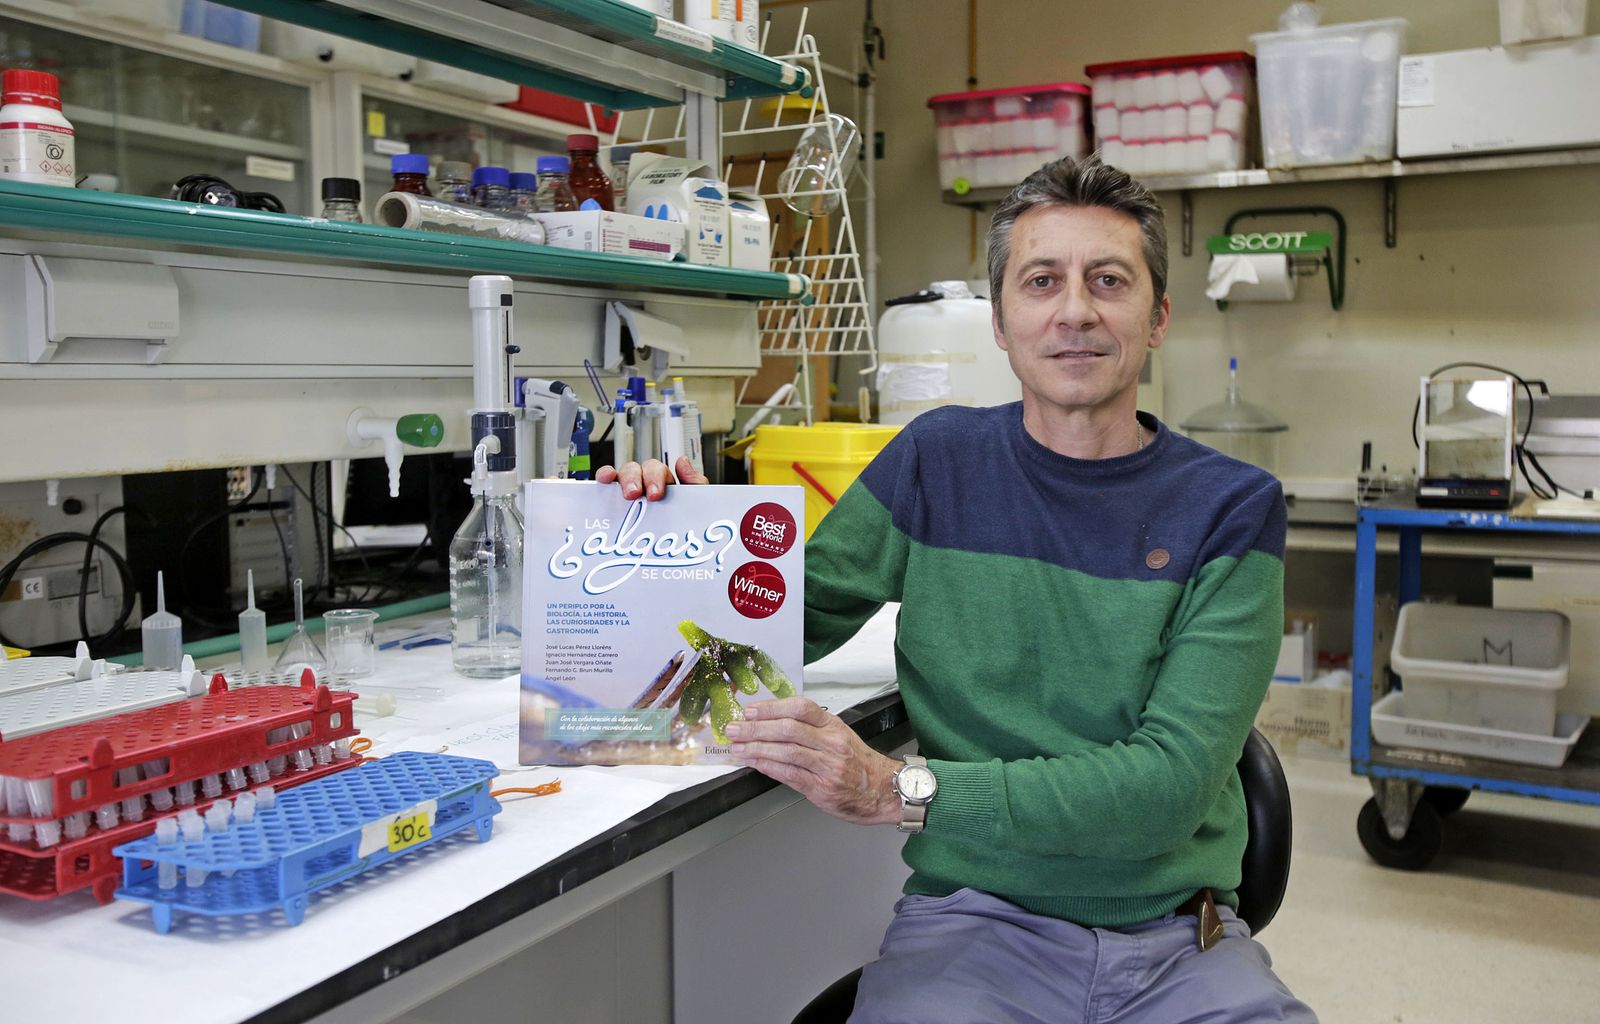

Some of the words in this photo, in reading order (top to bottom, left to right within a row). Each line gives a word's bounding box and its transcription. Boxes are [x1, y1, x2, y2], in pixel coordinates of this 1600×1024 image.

[641, 172, 683, 180] LABORATORY
[1228, 231, 1308, 251] SCOTT
[585, 518, 610, 530] LAS
[752, 514, 787, 538] Best
[761, 530, 784, 543] World
[641, 568, 658, 580] SE
[662, 568, 714, 580] COMEN
[734, 575, 783, 603] Winner
[1484, 637, 1512, 666] M
[545, 674, 561, 682] Ángel
